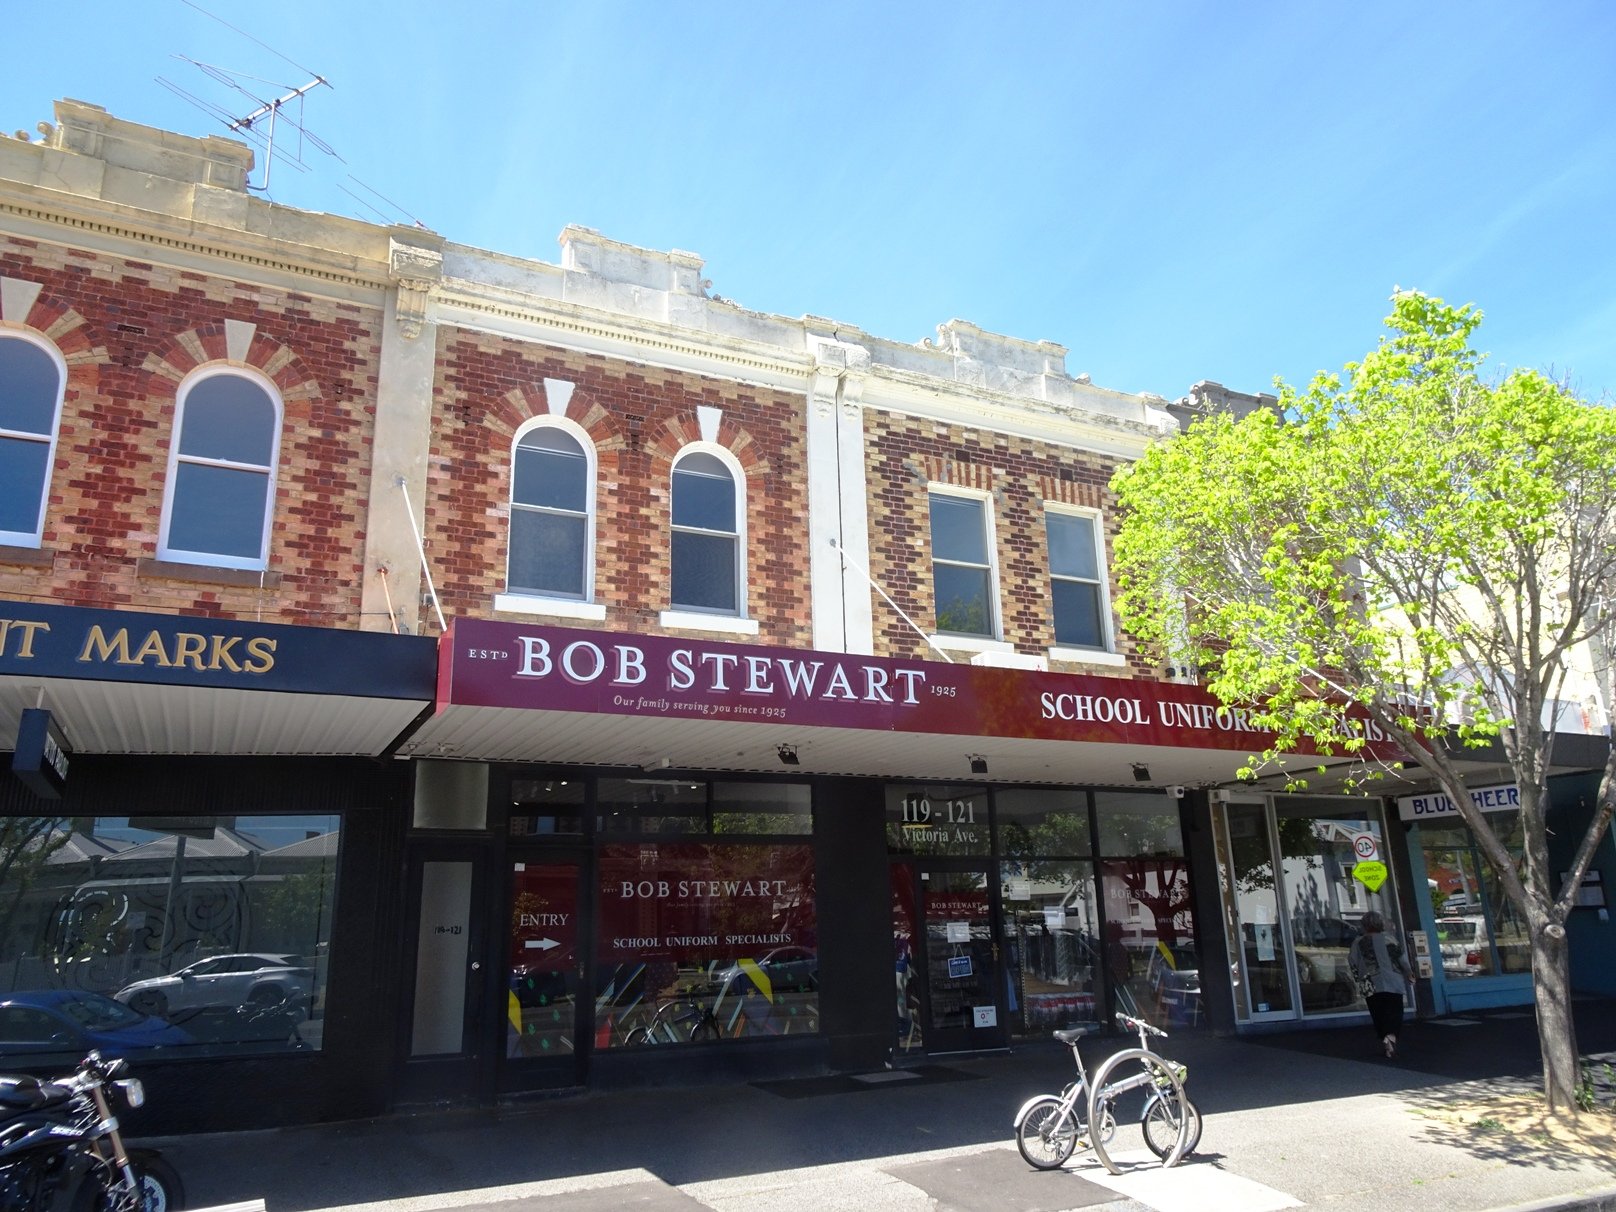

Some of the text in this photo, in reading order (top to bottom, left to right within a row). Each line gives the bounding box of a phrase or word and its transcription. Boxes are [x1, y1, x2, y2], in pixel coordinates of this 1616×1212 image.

[78, 624, 277, 673] MARKS
[514, 636, 647, 685] BOB
[668, 649, 926, 704] STEWART
[930, 685, 957, 697] 1925
[613, 695, 786, 718] Our family serving you since 1925
[1040, 692, 1150, 725] SCHOOL
[900, 799, 931, 823] 119
[946, 800, 975, 824] 121
[902, 827, 979, 843] Victoria Ave.
[620, 880, 787, 898] BOB STEWART
[931, 901, 981, 910] BOB STEWART
[520, 913, 569, 927] ENTRY
[613, 933, 792, 949] SCHOOL UNIFORM SPECIALISTS
